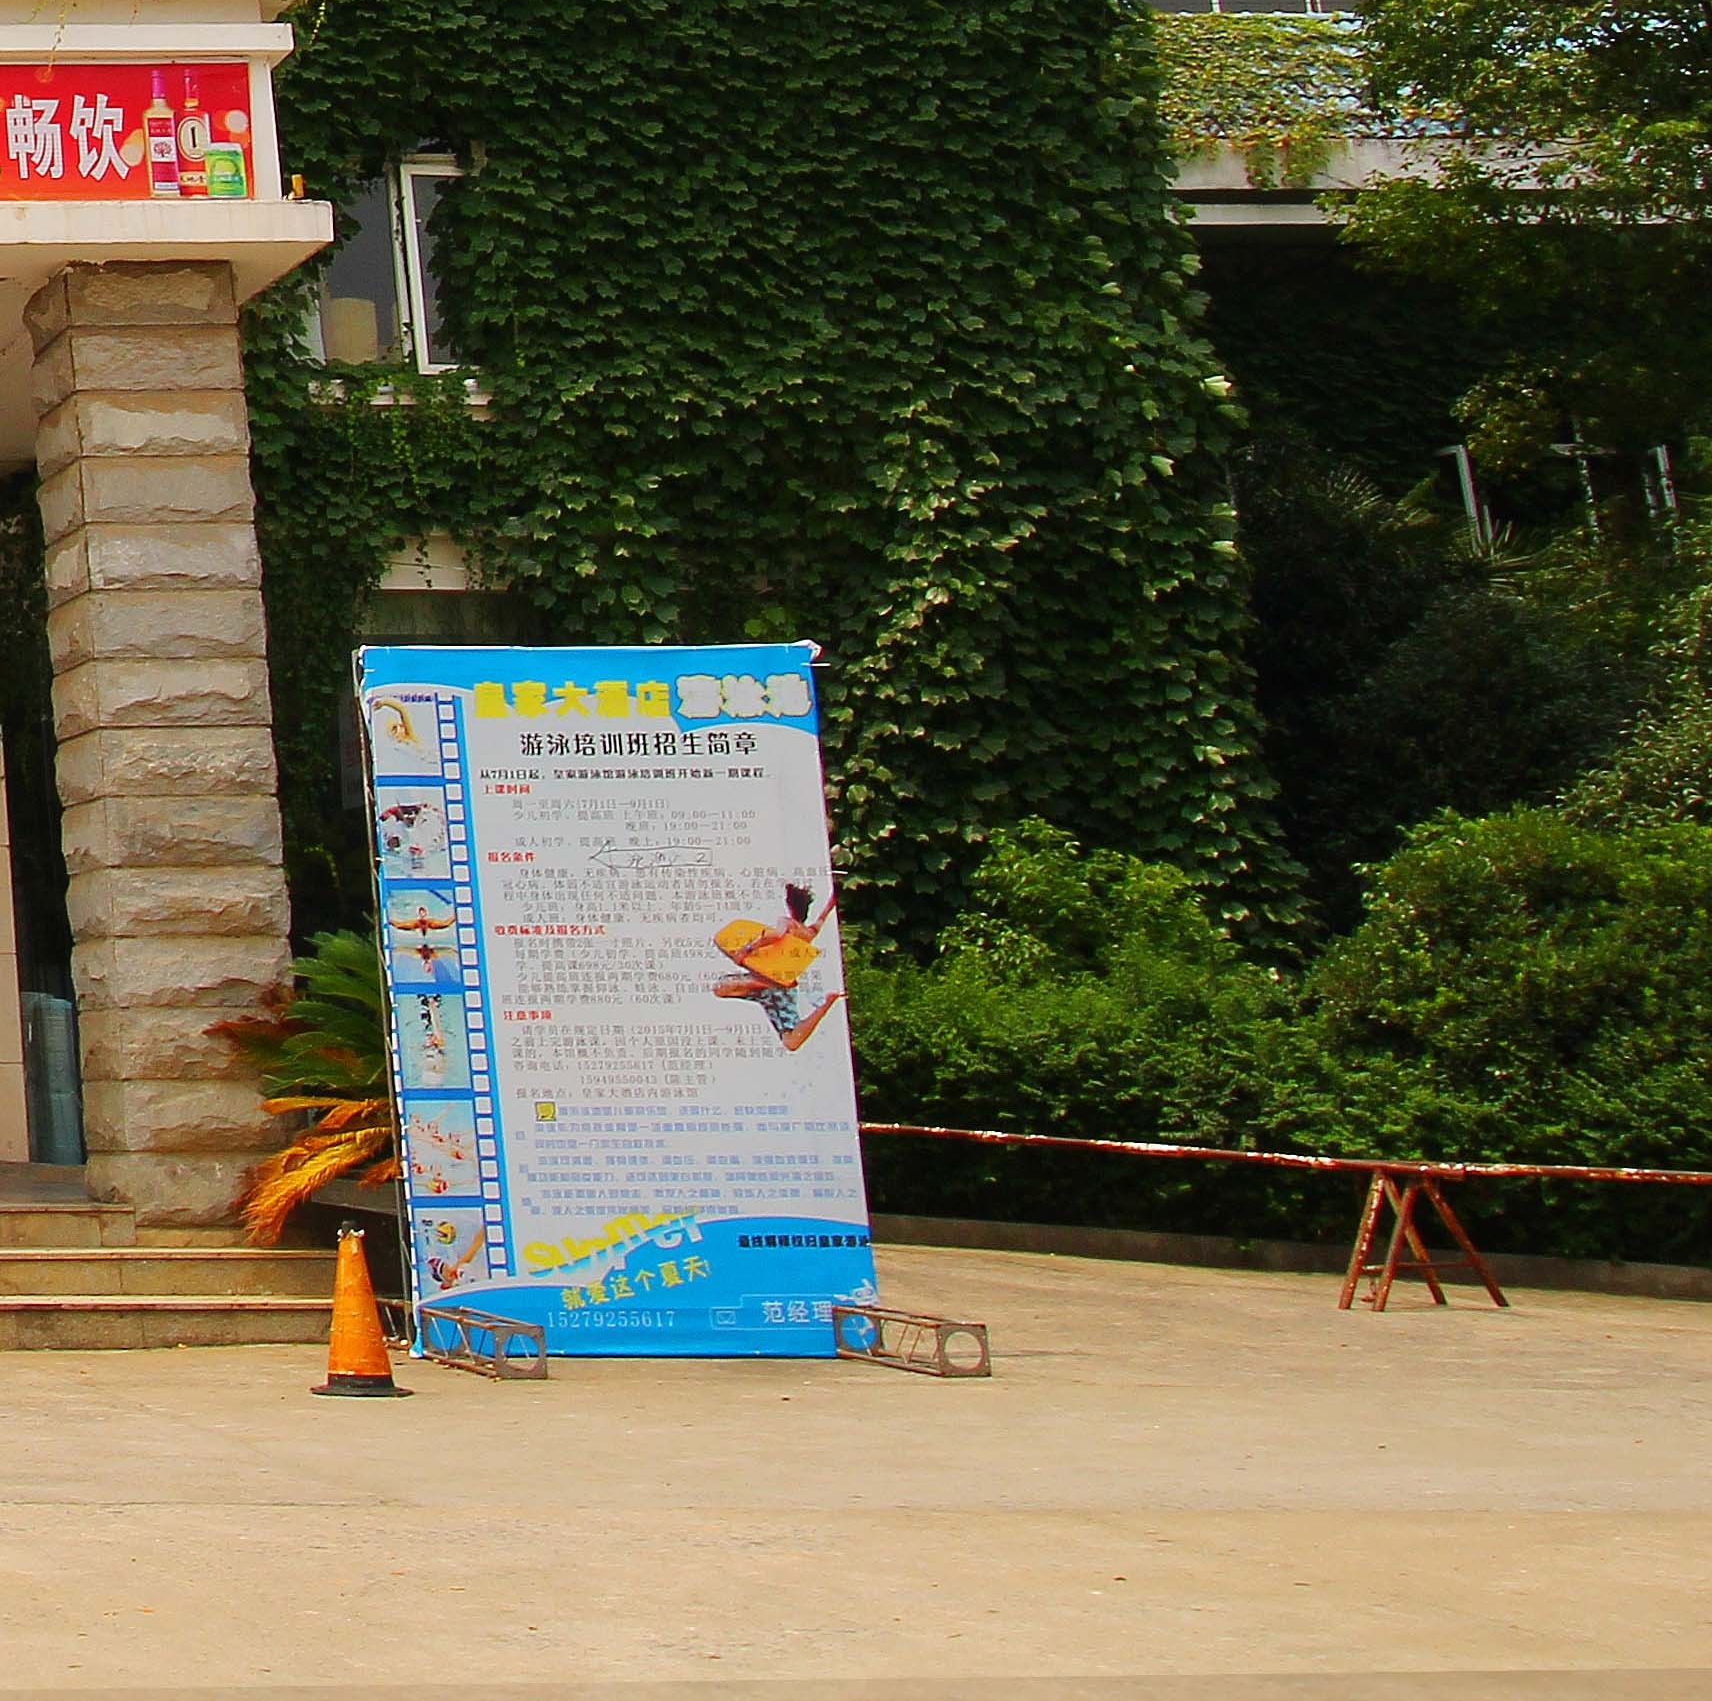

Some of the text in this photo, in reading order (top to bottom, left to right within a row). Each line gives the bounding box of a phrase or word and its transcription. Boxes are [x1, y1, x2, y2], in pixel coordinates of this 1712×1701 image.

[474, 680, 670, 719] 皇家大酒店
[520, 731, 758, 757] 游泳培训班招生简章
[548, 1310, 675, 1329] 15279255617
